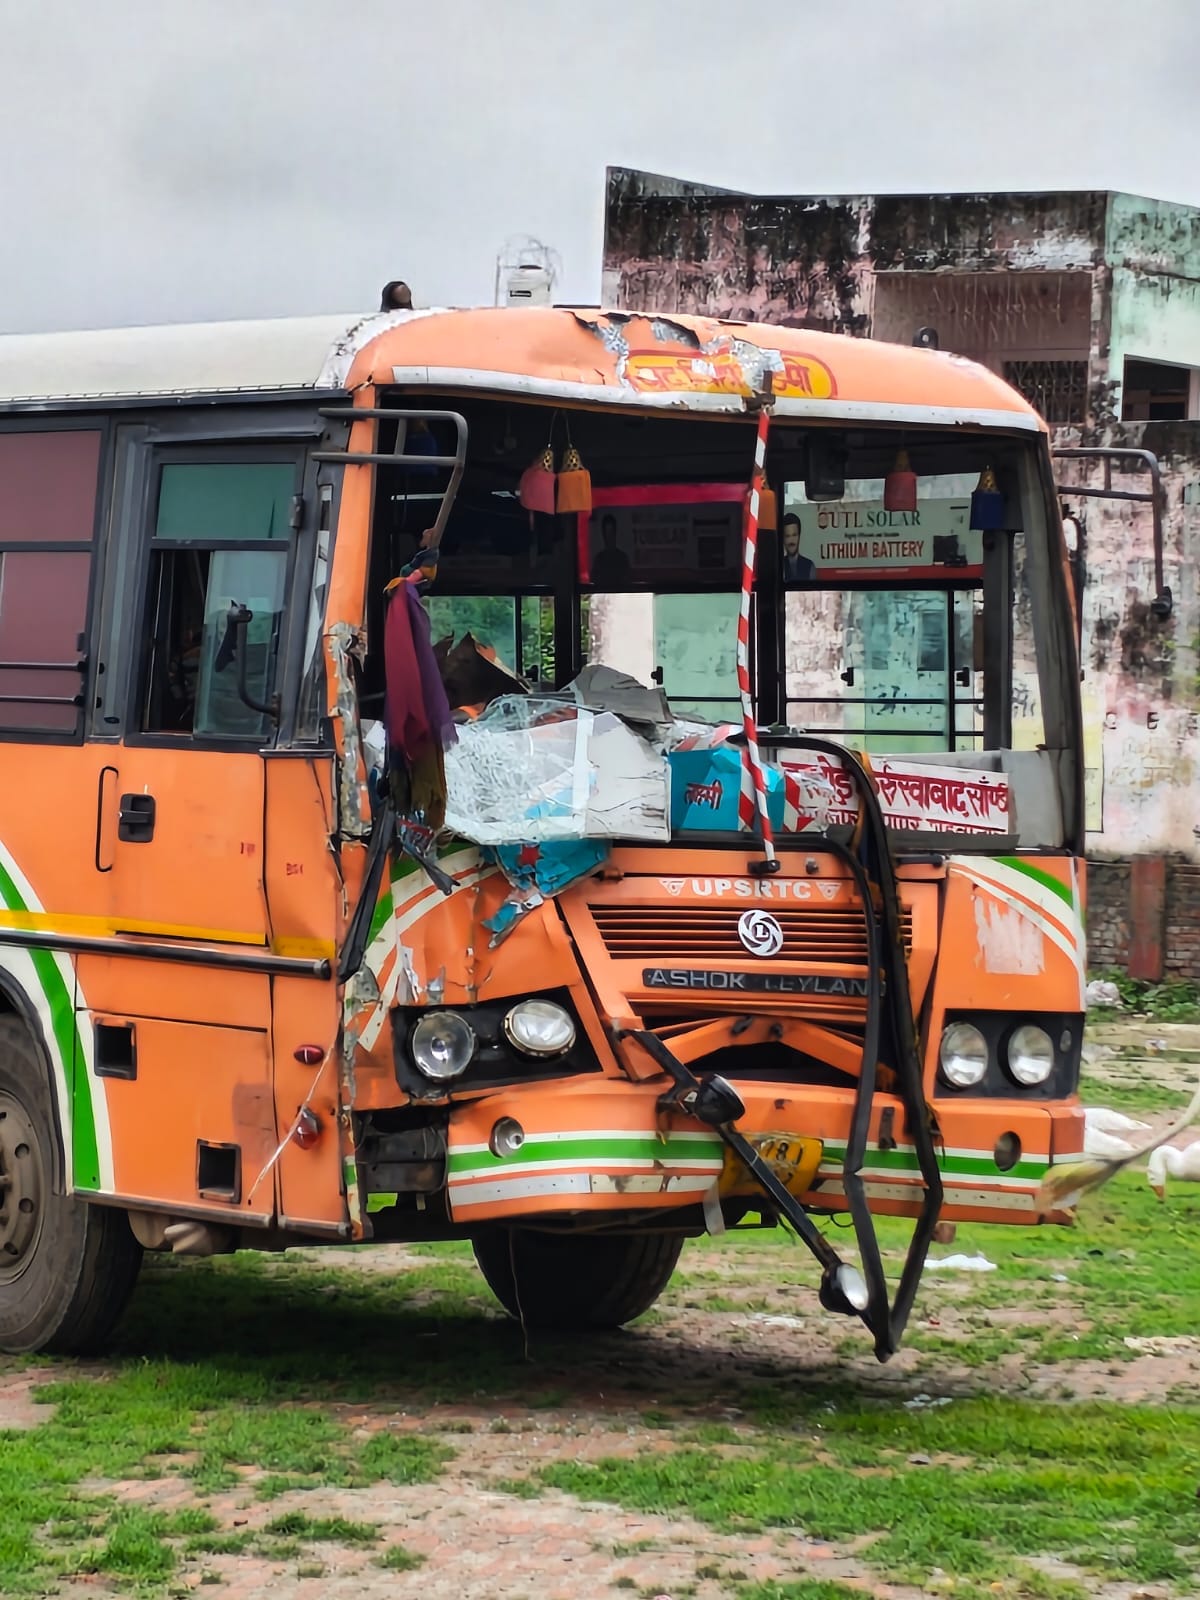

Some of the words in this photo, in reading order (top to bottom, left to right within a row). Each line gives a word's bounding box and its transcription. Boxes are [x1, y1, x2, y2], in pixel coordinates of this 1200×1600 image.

[867, 511, 921, 527] SOLAR
[820, 541, 868, 560] LITHIUM
[872, 540, 925, 559] BATTERY
[691, 878, 812, 899] UPSRTC
[650, 969, 745, 989] ASHOK
[765, 975, 868, 997] LEYLAN
